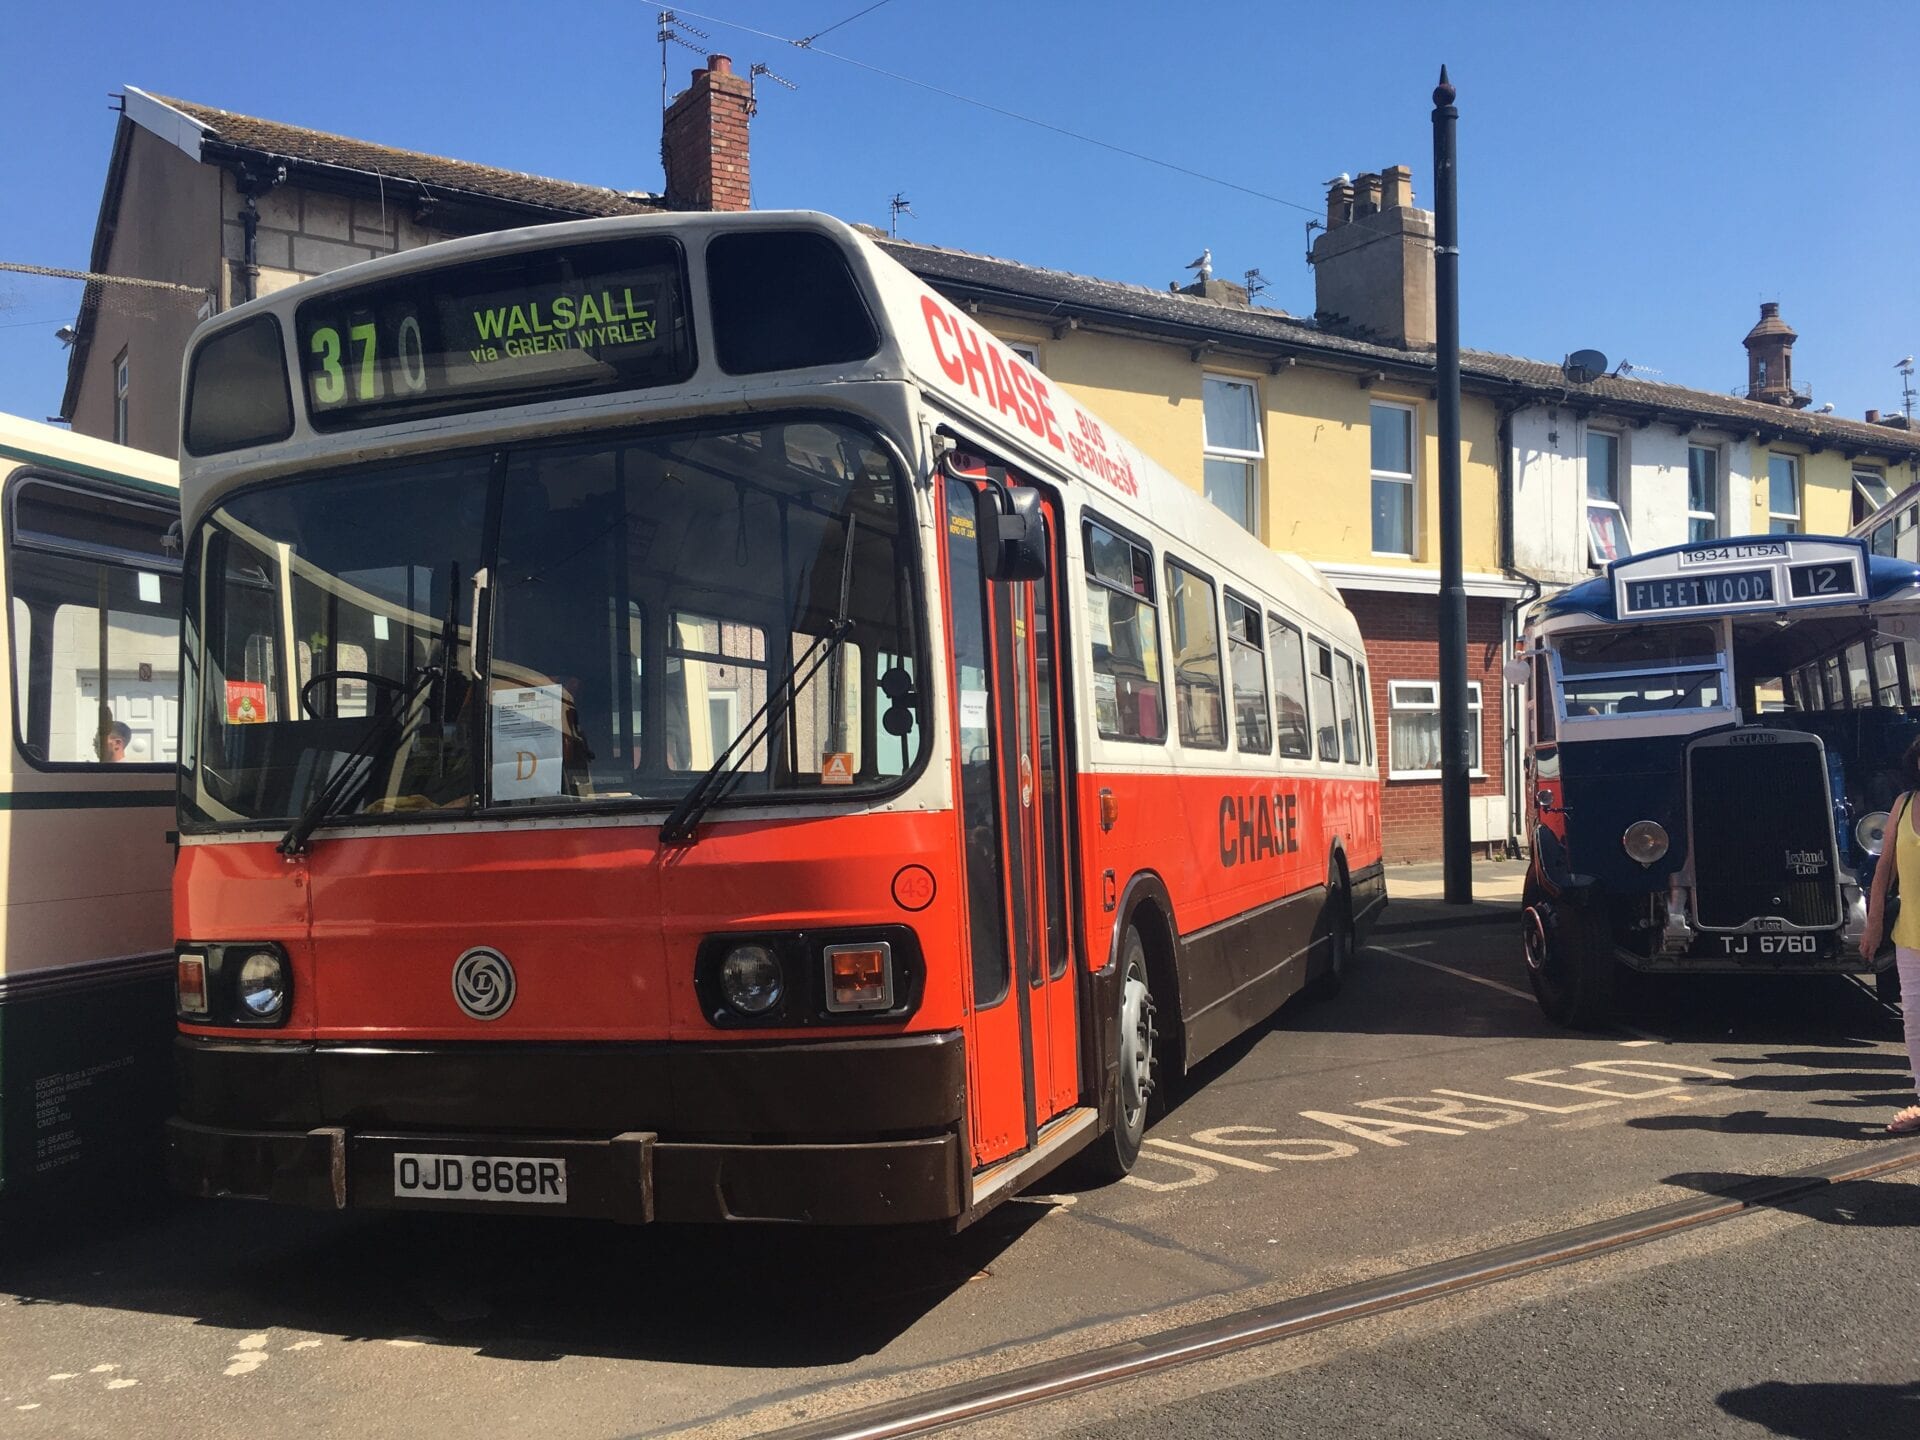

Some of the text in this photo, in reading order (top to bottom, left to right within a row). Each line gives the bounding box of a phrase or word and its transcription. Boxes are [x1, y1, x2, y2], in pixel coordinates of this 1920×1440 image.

[474, 288, 648, 340] WALSALL
[470, 320, 657, 363] via GREAT WYRLEY
[921, 294, 1065, 453] CHASE
[1074, 408, 1106, 452] BUS
[1068, 431, 1132, 496] SERVICES
[1686, 544, 1782, 563] 1934 LT5A
[1636, 576, 1765, 609] FLEETWOOD
[1808, 567, 1838, 593] 12
[516, 751, 537, 781] D
[829, 758, 846, 773] A
[1219, 794, 1299, 868] CHASE
[1796, 865, 1819, 875] Lion
[901, 877, 930, 898] 43
[1720, 935, 1816, 953] TJ 6760
[36, 1095, 66, 1109] HARLOW
[36, 1106, 60, 1119] ESSEX
[400, 1157, 560, 1195] OJD 868R
